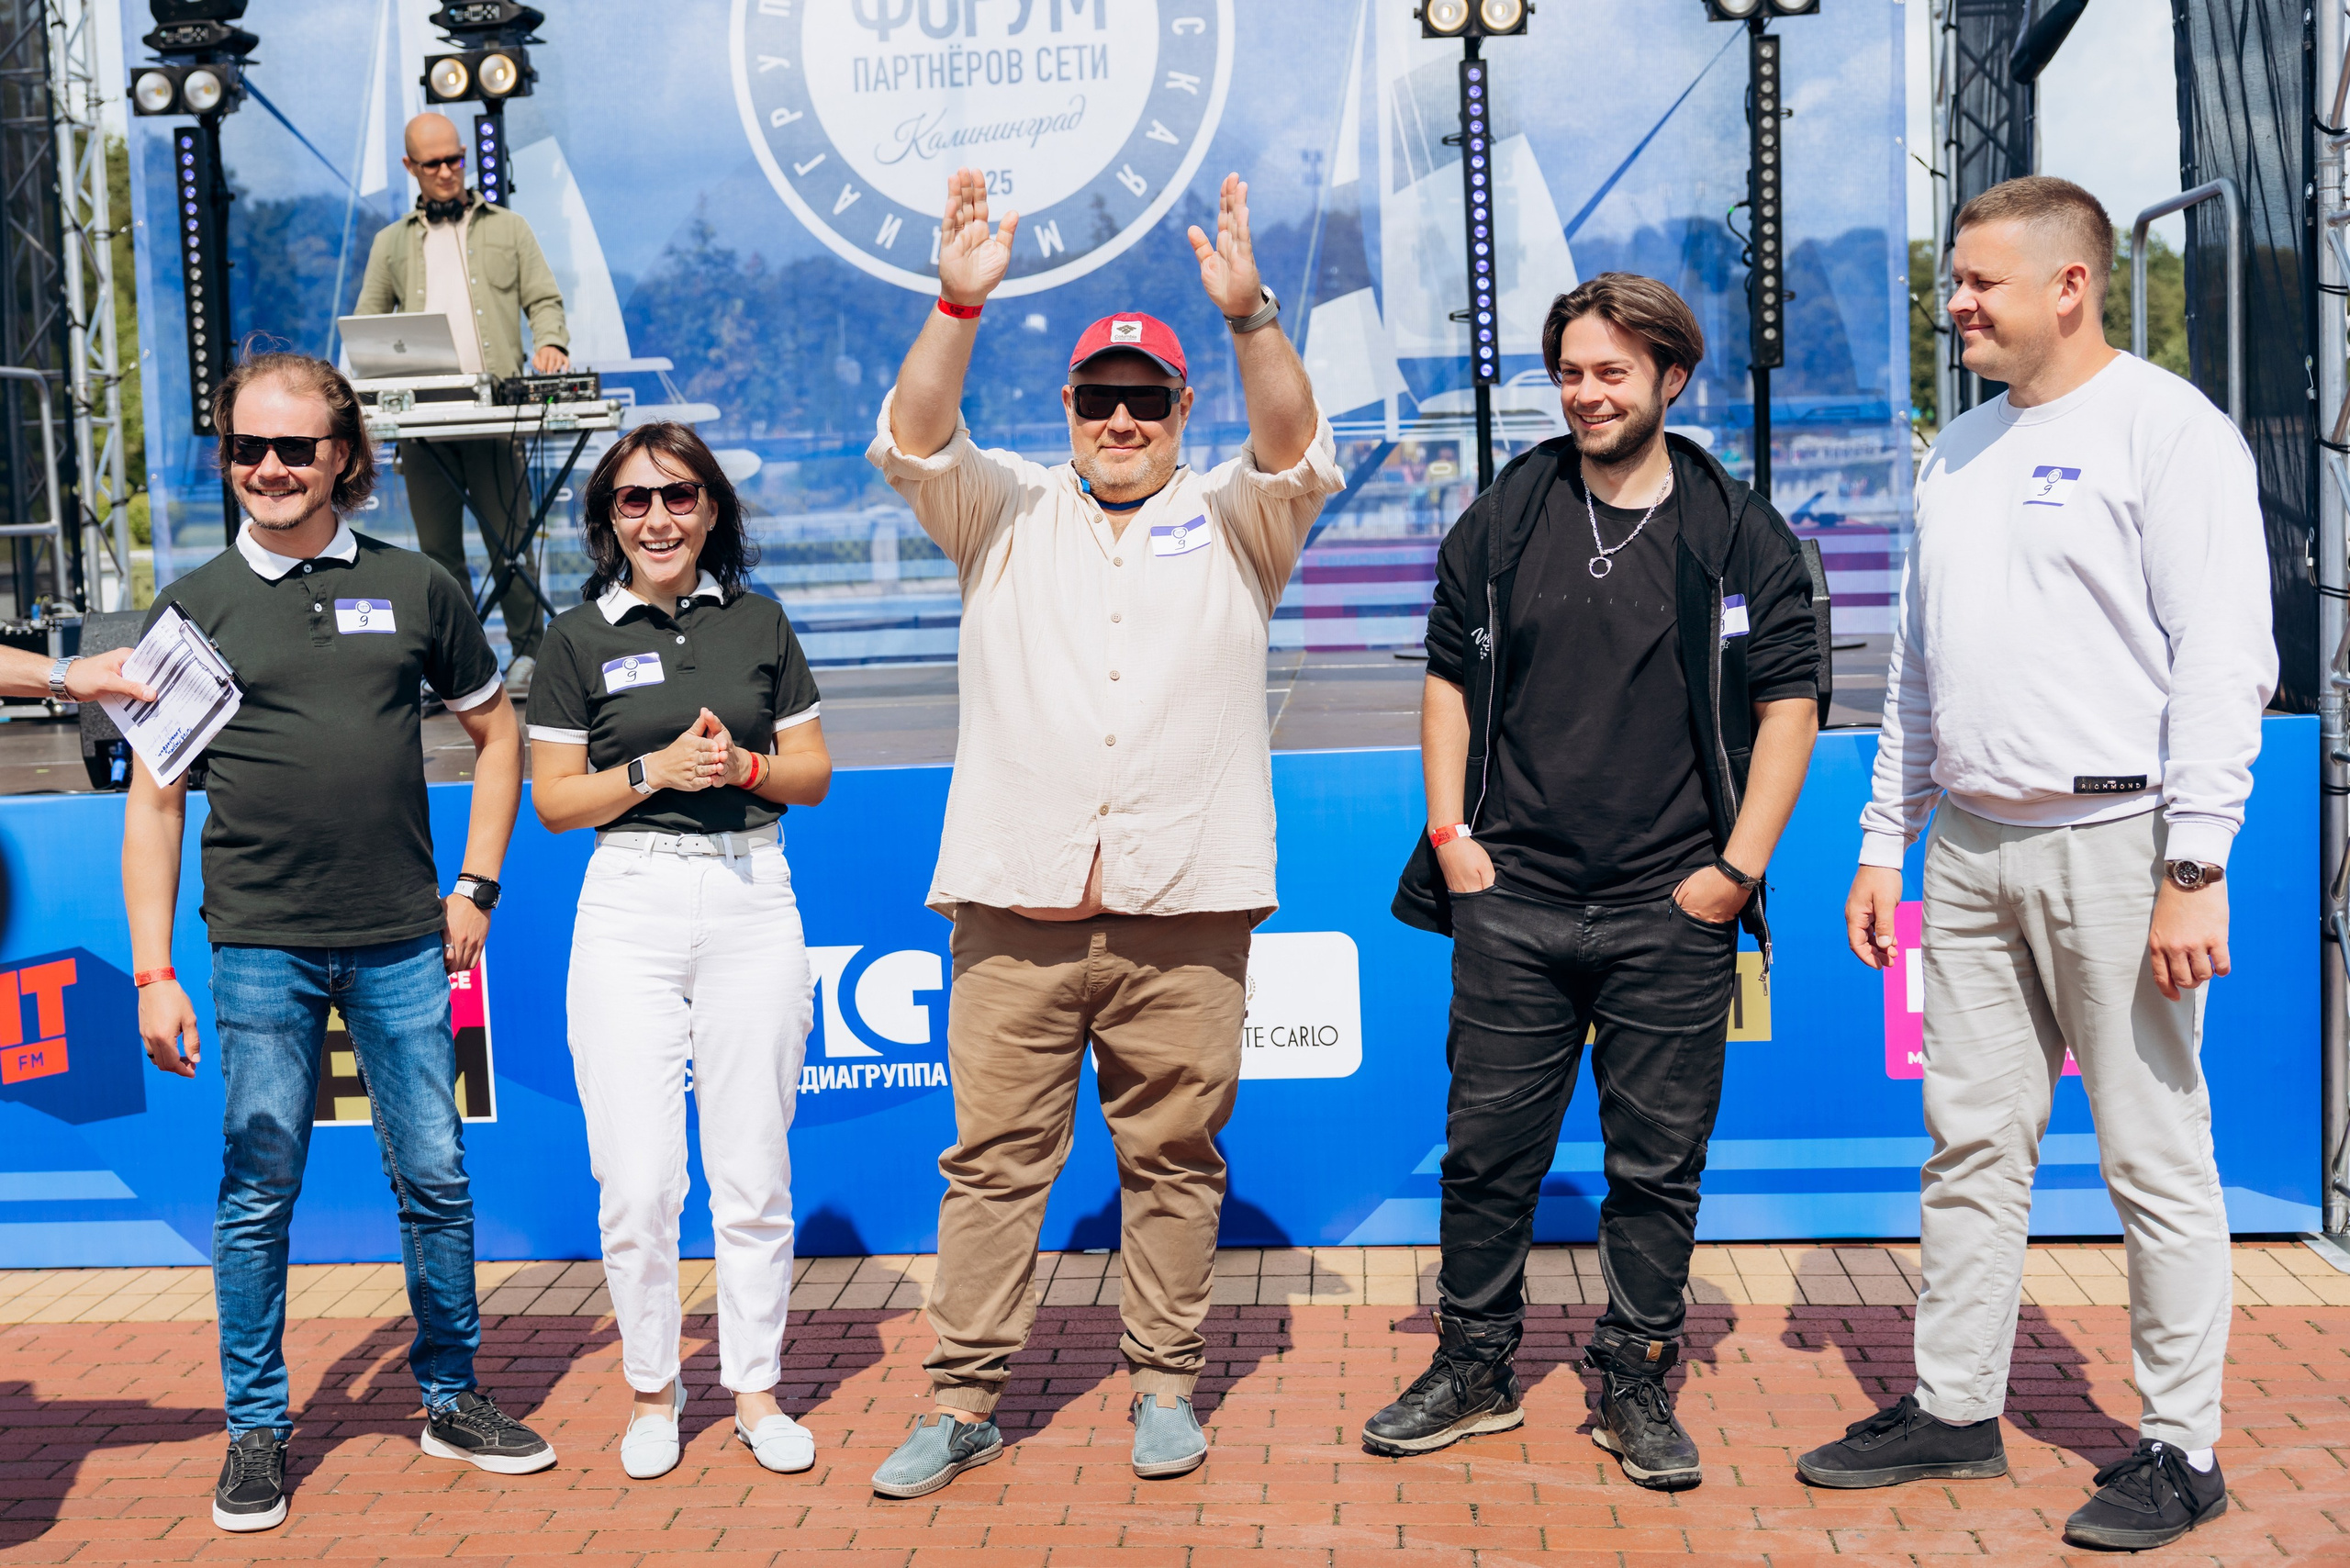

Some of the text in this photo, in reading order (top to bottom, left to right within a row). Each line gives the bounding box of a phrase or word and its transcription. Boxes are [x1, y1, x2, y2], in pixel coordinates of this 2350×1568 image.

[853, 44, 1109, 93] ПАРТНЁРОВ СЕТИ
[1116, 17, 1206, 198] СКАЯ
[874, 95, 1086, 164] Калининград
[986, 170, 1013, 196] 25
[2081, 782, 2141, 790] RICHMOND
[1270, 1025, 1338, 1047] CARLO
[18, 1051, 44, 1071] FM
[797, 1062, 949, 1094] ДИАГРУППА
